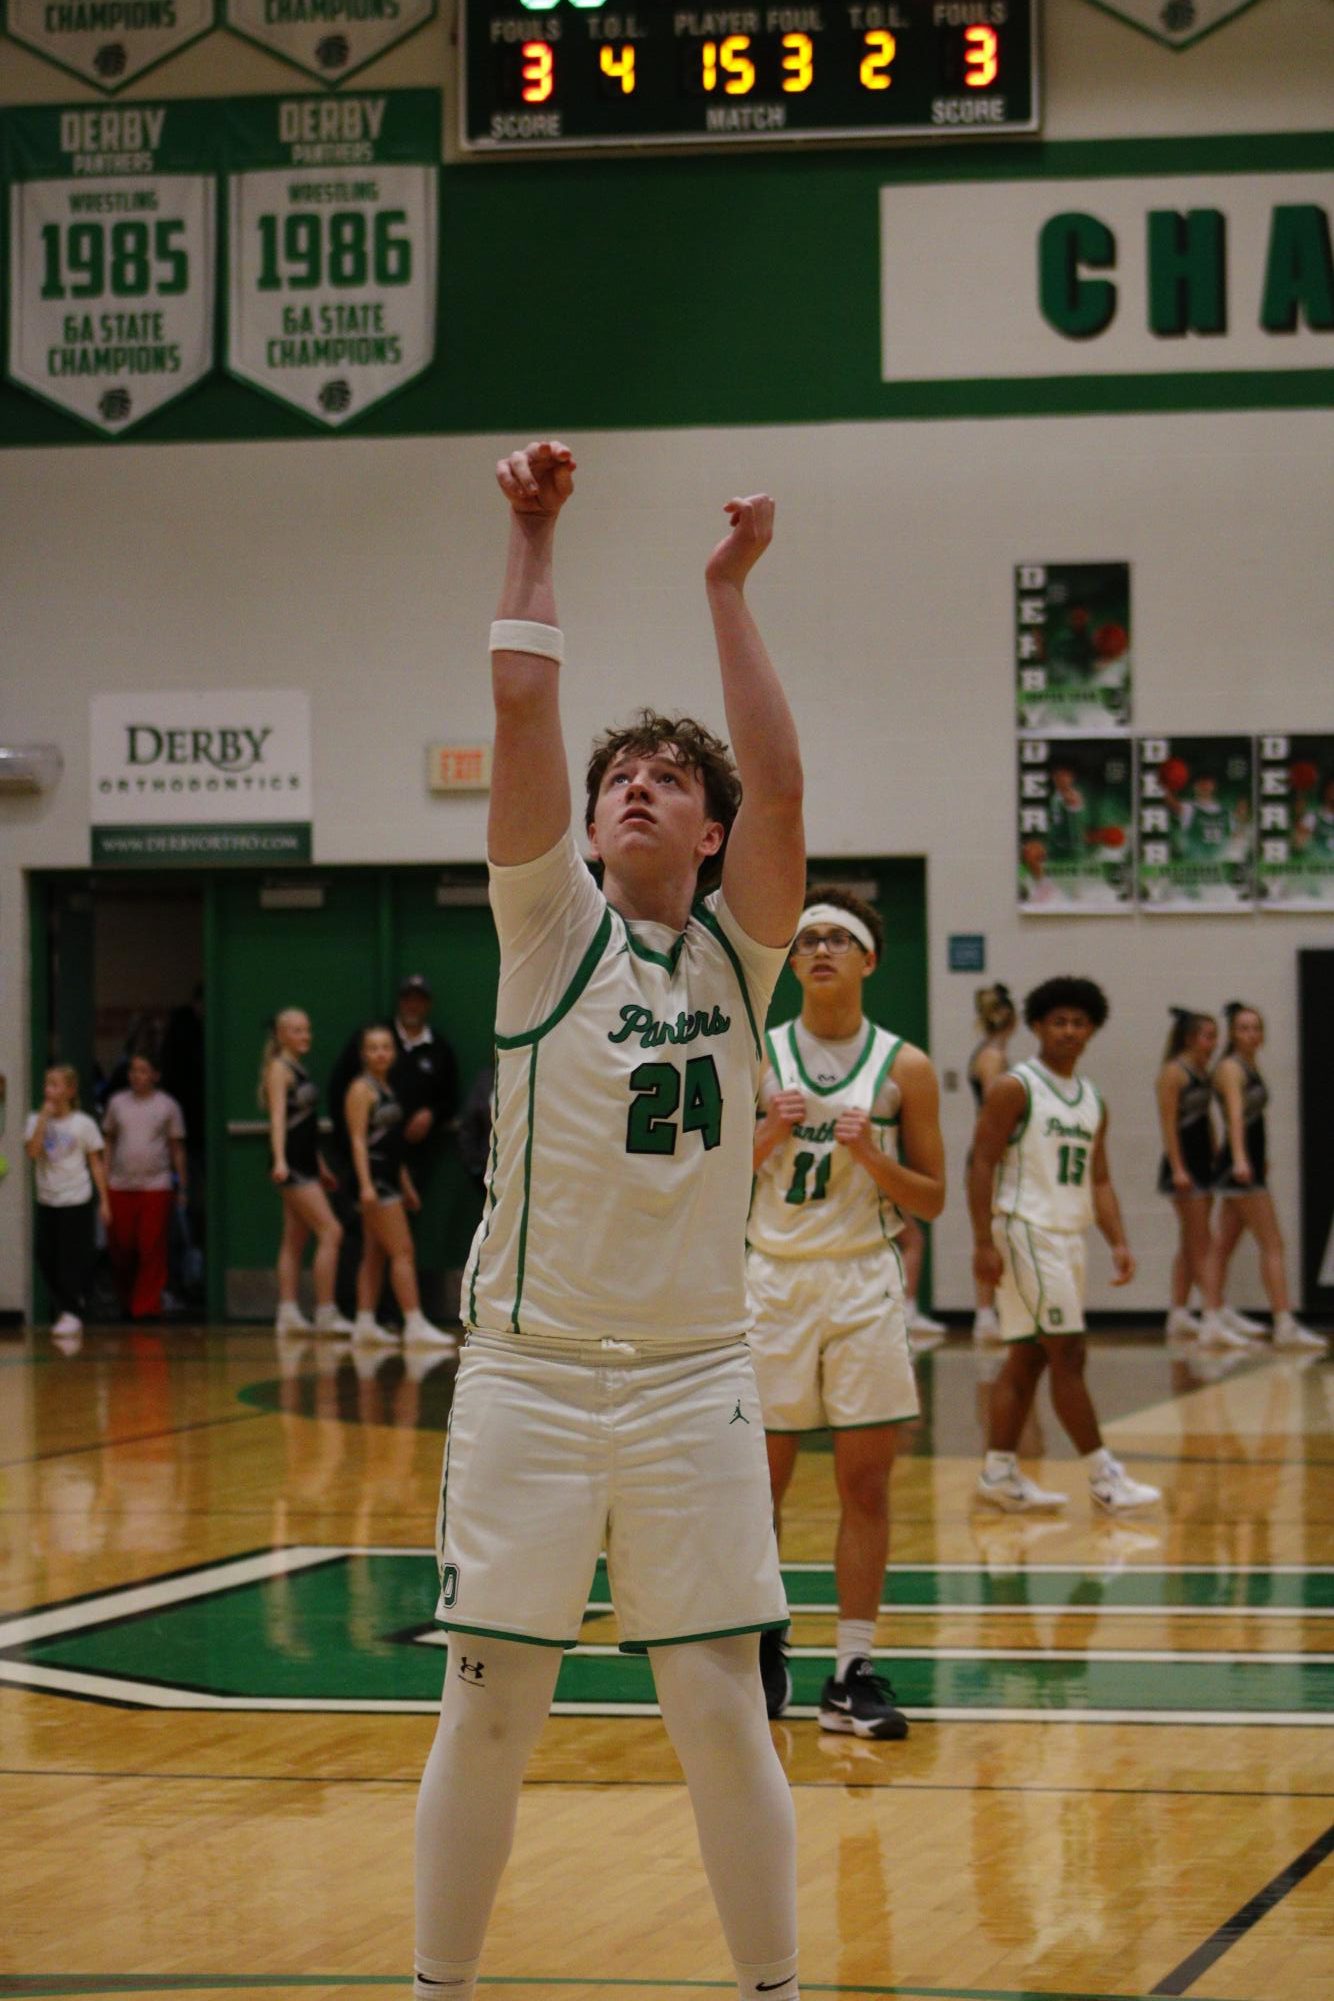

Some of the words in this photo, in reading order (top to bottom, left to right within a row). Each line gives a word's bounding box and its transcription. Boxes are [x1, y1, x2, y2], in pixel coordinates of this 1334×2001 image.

[490, 17, 561, 43] FOULS
[674, 11, 759, 36] PLAYER
[766, 8, 823, 32] FOUL
[933, 1, 1008, 27] FOULS
[522, 40, 553, 102] 3
[600, 45, 635, 94] 4
[703, 34, 755, 94] 15
[782, 32, 813, 92] 3
[859, 29, 896, 90] 2
[964, 23, 998, 86] 3
[279, 99, 386, 143] DERBY
[491, 113, 561, 138] SCORE
[706, 104, 786, 130] MATCH
[932, 97, 1005, 124] SCORE
[60, 108, 167, 152] DERBY
[73, 152, 154, 174] PANTHERS
[291, 142, 375, 164] PANTHERS
[68, 191, 158, 213] WRESTLING
[288, 182, 380, 204] WRESTLING
[41, 219, 189, 299] 1985
[257, 210, 412, 291] 1986
[1038, 204, 1334, 342] CHA
[63, 314, 93, 343] 6A
[99, 312, 165, 342] STATE
[282, 305, 316, 334] 6A
[319, 303, 385, 333] STATE
[48, 344, 181, 377] CHAMPIONS
[266, 336, 401, 369] CHAMPIONS
[126, 725, 272, 772] DERBY
[99, 776, 300, 794] ORTHODONTICS
[626, 1054, 723, 1155] 24
[784, 1151, 831, 1205] 11
[1057, 1143, 1087, 1187] 15
